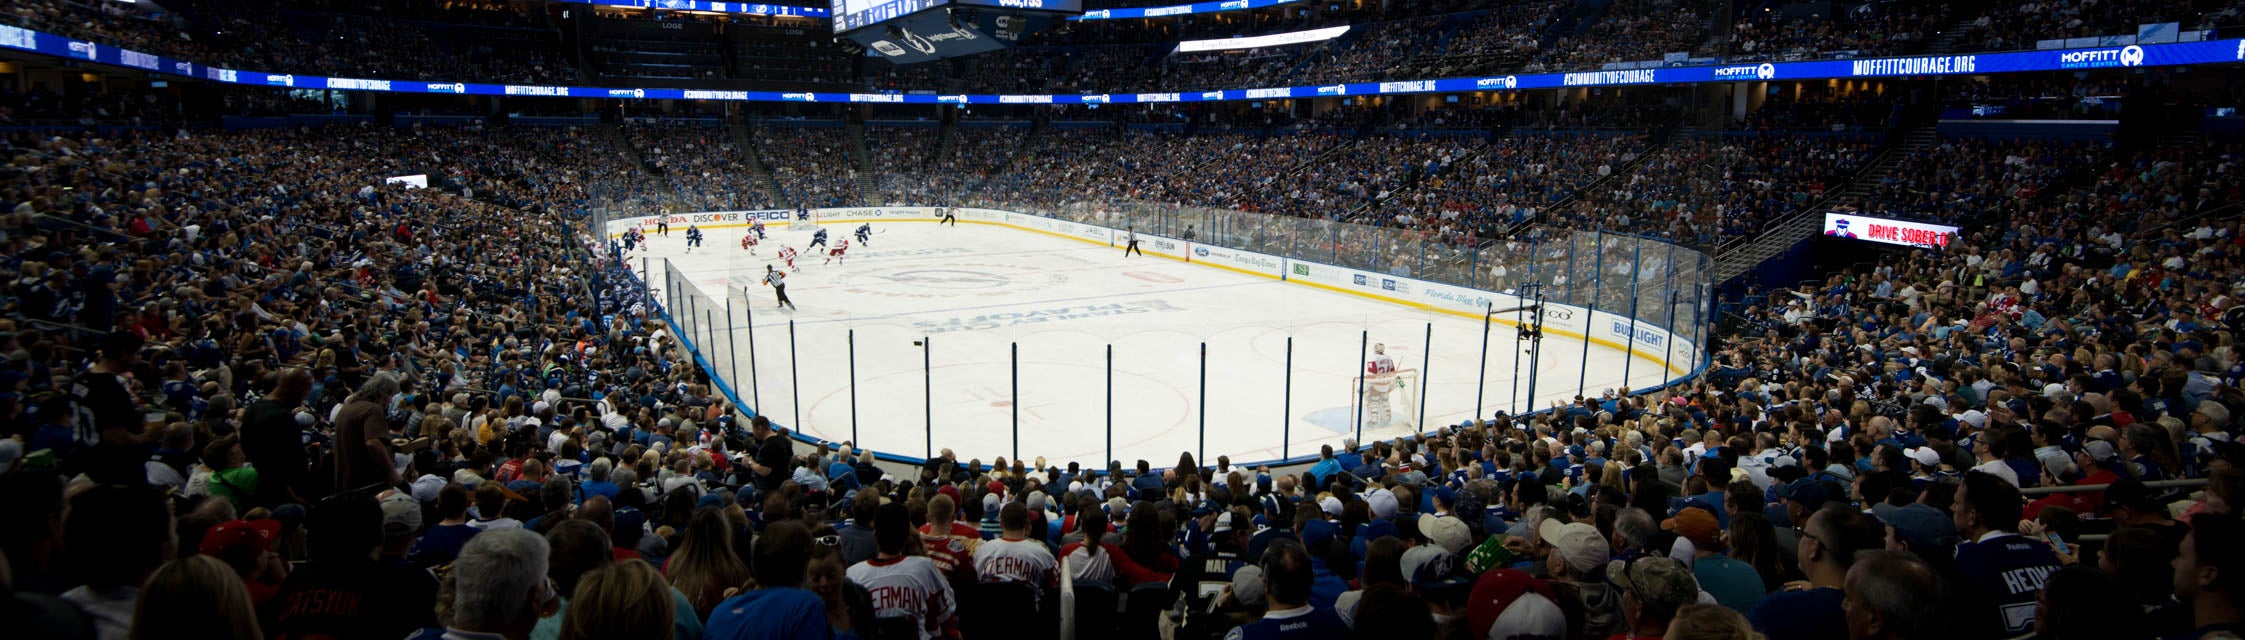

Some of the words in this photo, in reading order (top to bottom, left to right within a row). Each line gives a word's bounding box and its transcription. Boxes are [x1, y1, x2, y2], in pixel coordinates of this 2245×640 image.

[662, 22, 684, 30] LOGE
[2061, 50, 2119, 63] MOFFITT
[1715, 66, 1757, 76] MOFFITT
[1852, 56, 1976, 76] MOFFITTCOURAGE.ORG
[1477, 78, 1505, 86] MOFFITT
[1563, 69, 1655, 86] #COMMUNITYOFCOURAGE
[327, 77, 391, 91] #COMMUNITYOFCOURAGE
[427, 83, 454, 91] MOFFITT
[1379, 79, 1436, 93] MOFFITTCOURAGE.ORG
[505, 85, 569, 97] MOFFITTCOURAGE.ORG
[608, 89, 634, 97] MOFFITT
[849, 93, 904, 103] MOFFITTCOURAGE.ORG
[644, 216, 687, 226] HODA
[693, 213, 739, 223] DISCOVER
[745, 211, 790, 220] GEICO
[1868, 224, 1899, 241] DRIVE
[1900, 227, 1936, 245] SOBER
[1424, 288, 1454, 301] Florida
[1455, 294, 1474, 306] Blue
[1541, 308, 1571, 321] ECO
[1635, 329, 1664, 347] LIGHT
[2001, 565, 2062, 595] HEDM
[870, 585, 922, 614] ERMAN
[1280, 621, 1309, 632] Reebok
